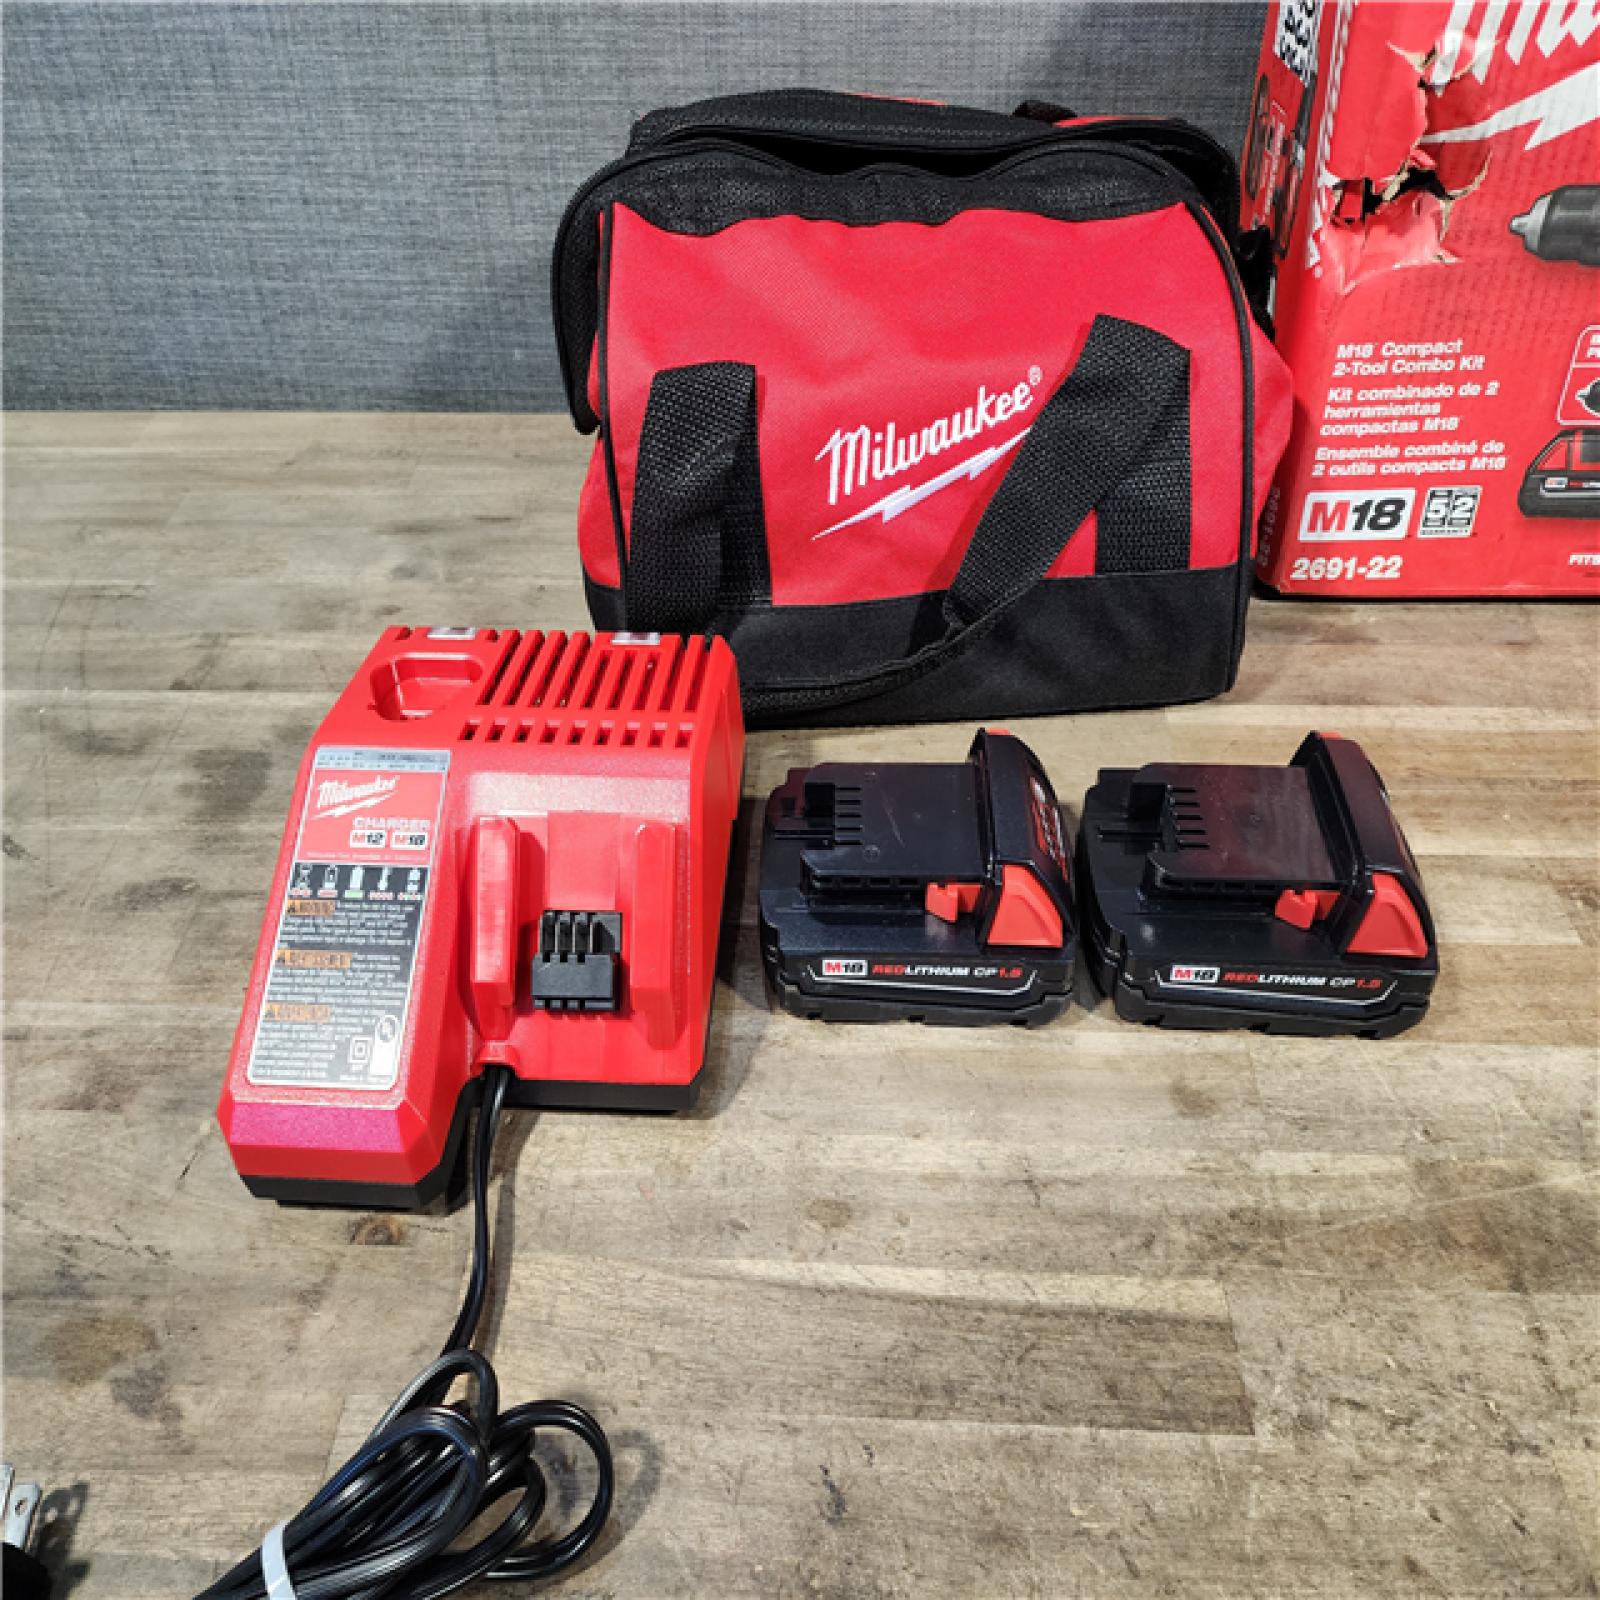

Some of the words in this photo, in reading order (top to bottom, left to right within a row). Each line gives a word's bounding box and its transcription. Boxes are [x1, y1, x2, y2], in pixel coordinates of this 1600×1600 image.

[1381, 338, 1463, 357] Compact
[1332, 360, 1388, 376] 2-Tool
[1392, 357, 1455, 373] Combo
[1459, 355, 1485, 370] Kit
[1328, 387, 1353, 403] Kit
[1357, 383, 1455, 401] combinado
[1458, 382, 1481, 396] de
[1485, 380, 1499, 396] 2
[1324, 402, 1441, 419] herramientas
[1320, 420, 1419, 438] compactas
[1422, 417, 1459, 431] M18
[814, 385, 1034, 505] Milwaukee
[1315, 444, 1400, 460] Ensemble
[1404, 440, 1478, 456] combiné
[1482, 440, 1505, 454] de
[1312, 464, 1325, 476] 2
[1329, 462, 1376, 476] outils
[1380, 458, 1466, 475] compacts
[1470, 457, 1506, 470] M18
[1307, 497, 1406, 533] M18
[1290, 555, 1403, 580] 2691-22
[824, 961, 863, 974] M18
[1174, 969, 1217, 981] M18
